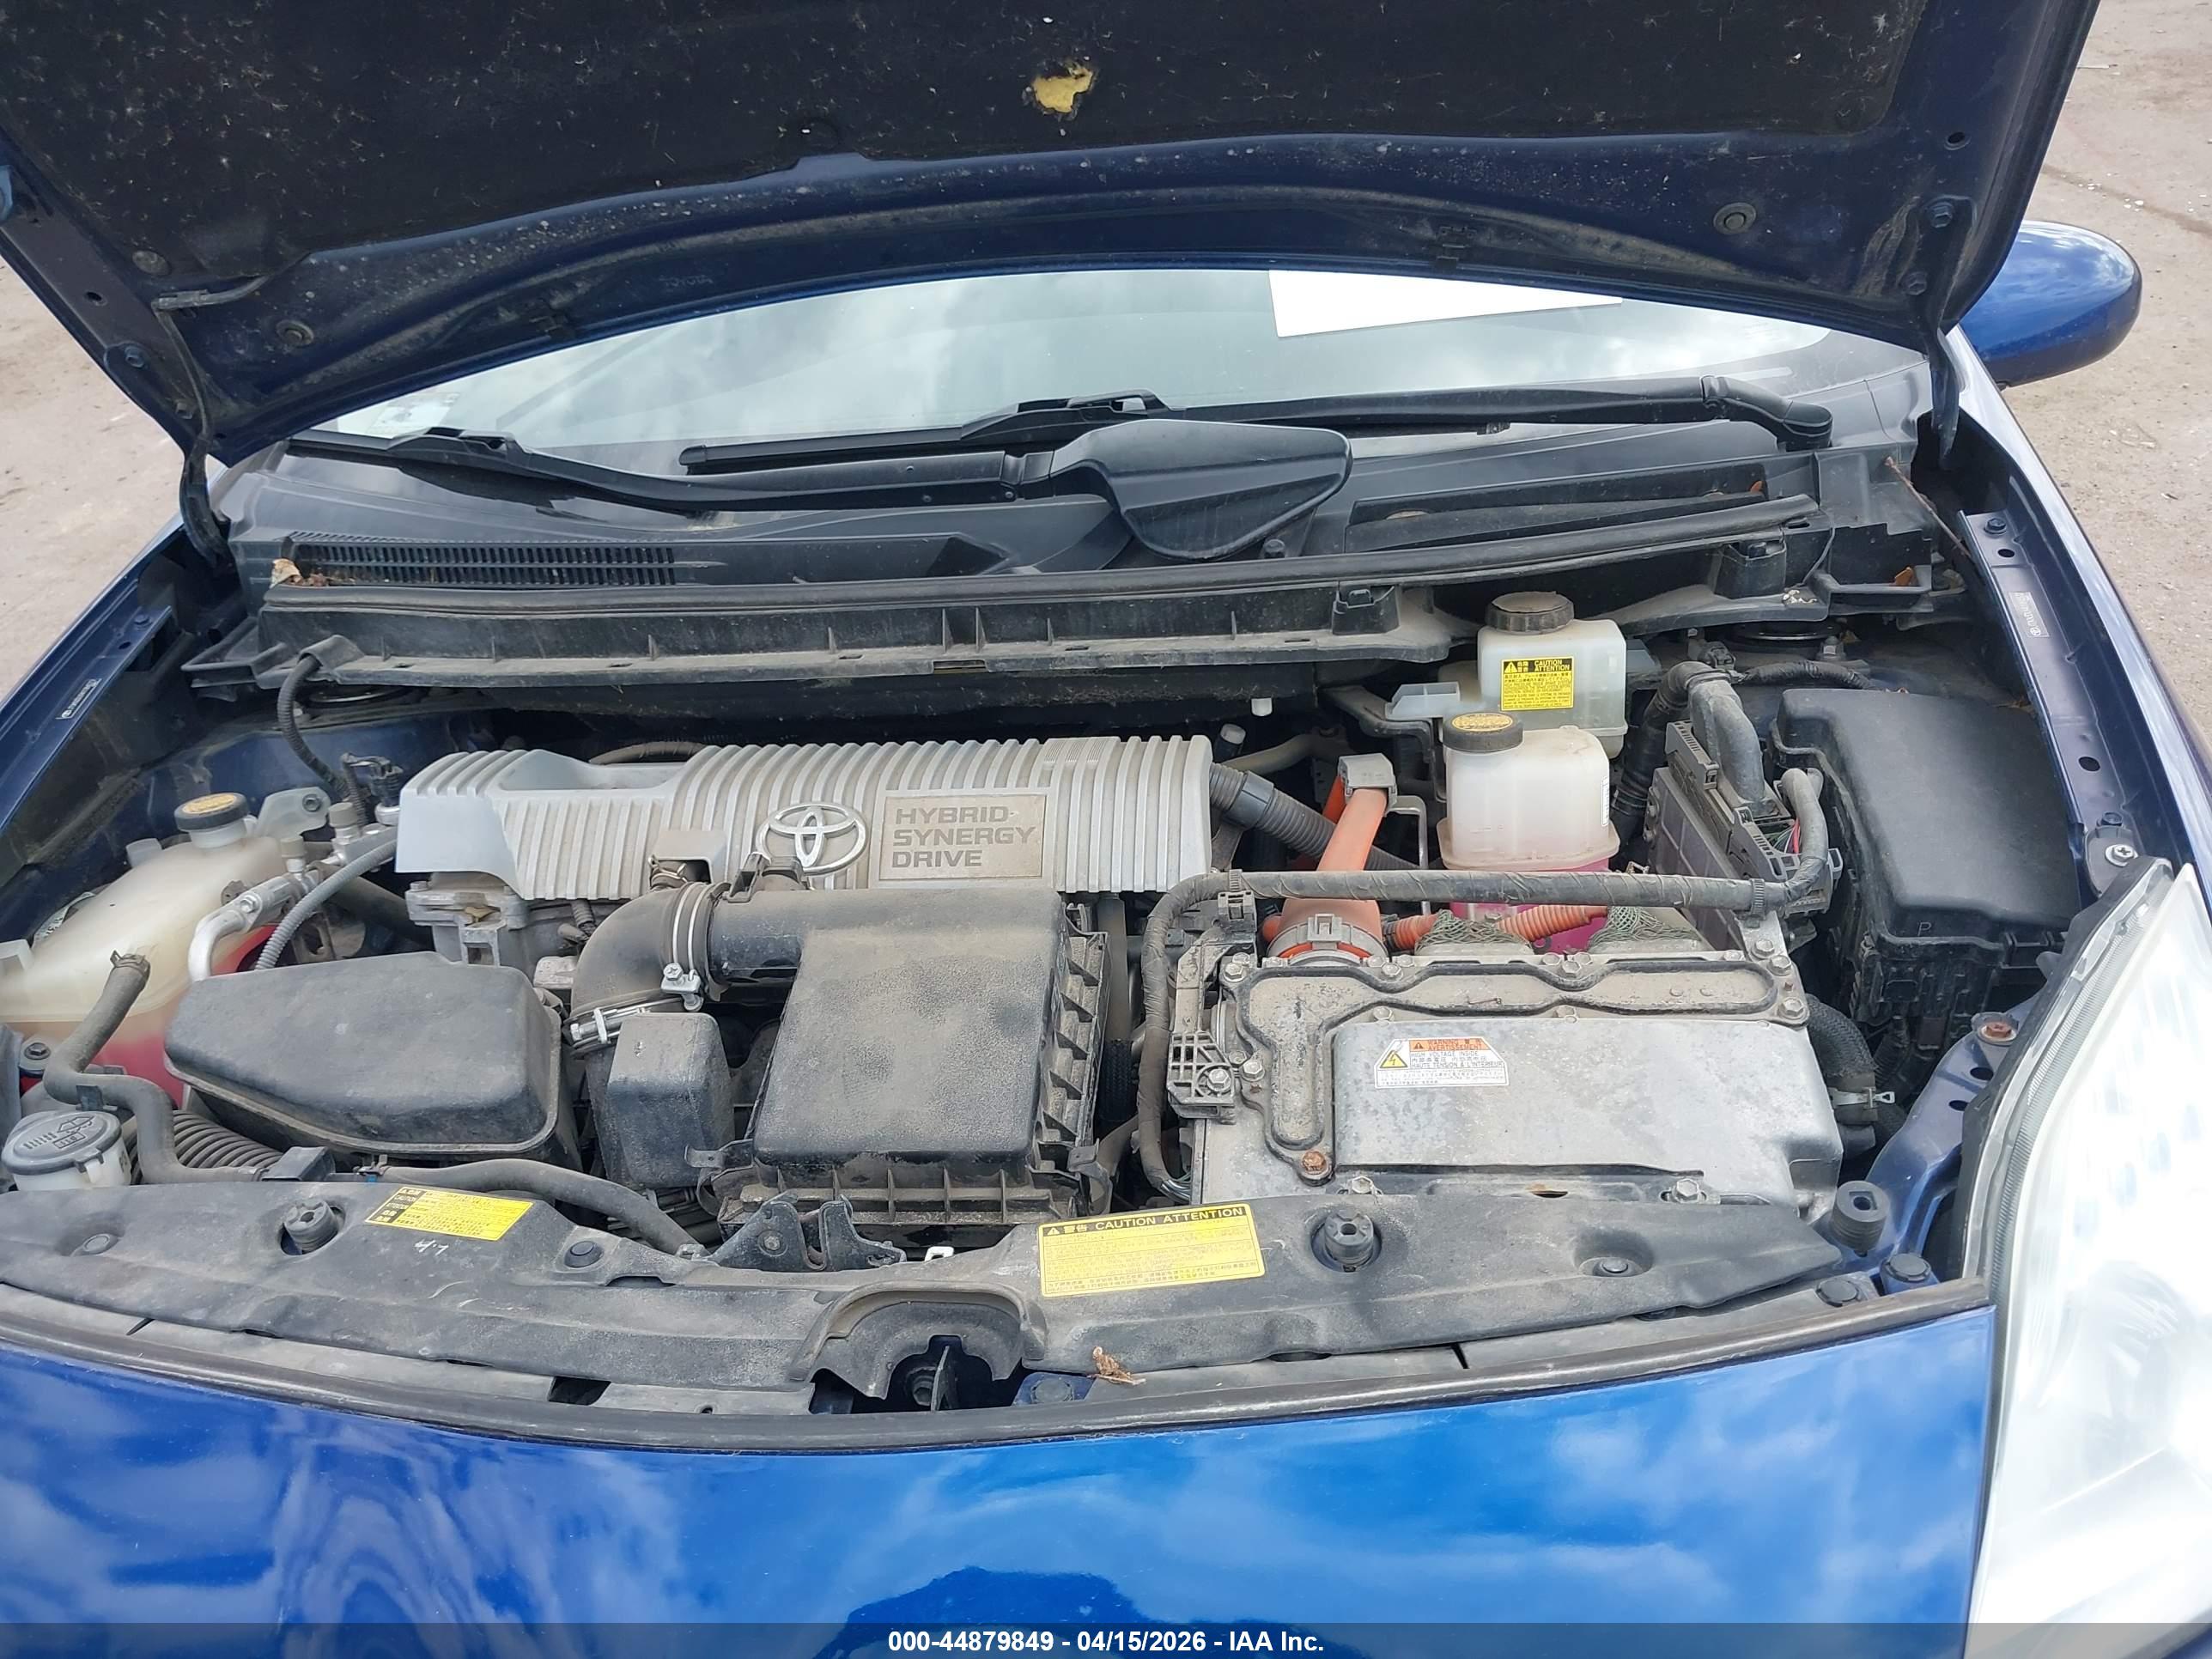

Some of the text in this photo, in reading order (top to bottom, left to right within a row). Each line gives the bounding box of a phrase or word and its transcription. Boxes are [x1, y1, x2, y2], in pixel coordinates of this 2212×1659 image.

[896, 806, 1009, 824] HYBRID
[893, 826, 1036, 847] SYNERGY
[892, 850, 982, 868] DRIVE
[1095, 1217, 1156, 1230] CAUTION
[1164, 1208, 1243, 1223] ATTENTION
